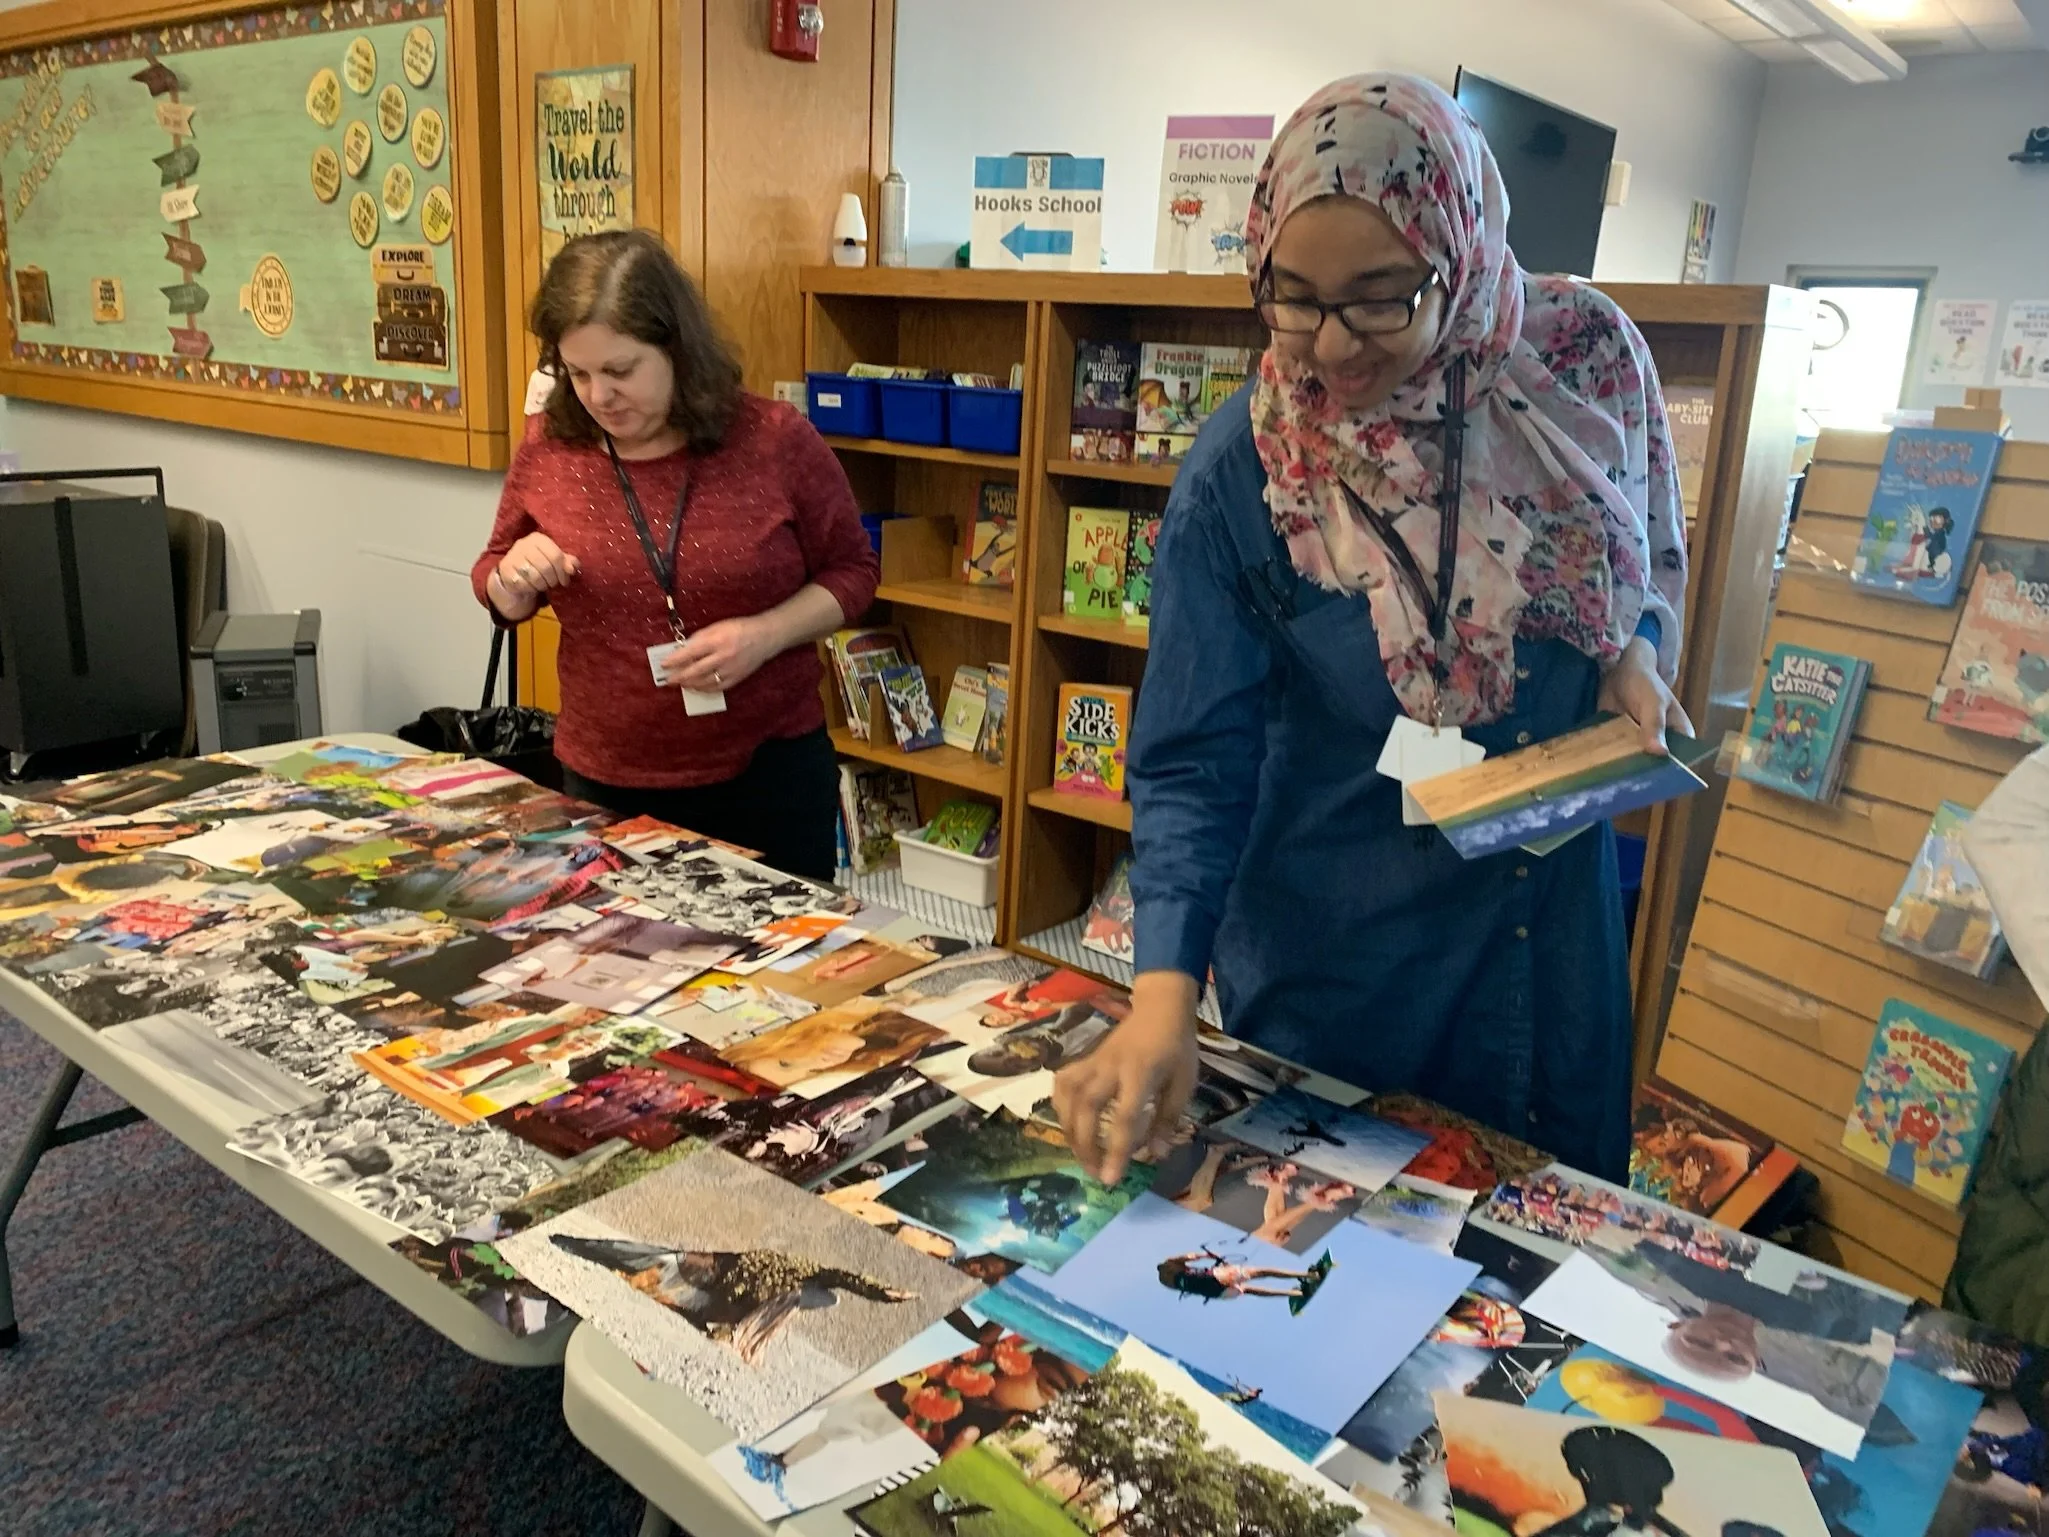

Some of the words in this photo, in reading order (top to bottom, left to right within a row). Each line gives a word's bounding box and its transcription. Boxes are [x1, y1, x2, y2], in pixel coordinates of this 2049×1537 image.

[544, 101, 594, 138] Travel
[598, 99, 625, 134] the
[547, 138, 623, 182] World
[1178, 143, 1256, 160] FICTION
[1169, 171, 1217, 186] Graphic
[553, 184, 617, 225] through
[974, 195, 1033, 212] Hooks
[1038, 196, 1102, 213] School
[381, 250, 425, 263] EXPLORE
[393, 287, 432, 302] DREAM
[386, 325, 435, 342] DISCOVER
[1156, 349, 1204, 362] Frankie
[1154, 361, 1204, 378] Dragon
[1667, 403, 1713, 416] ABY-SITT
[1680, 413, 1709, 425] CLUB
[1084, 526, 1128, 552] APPLE
[1087, 588, 1118, 609] PIE
[2015, 580, 2049, 604] POS
[1783, 655, 1828, 682] KATIE
[1771, 671, 1837, 705] CATSITTER
[1068, 696, 1116, 722] SIDE
[1065, 715, 1120, 740] KICKS
